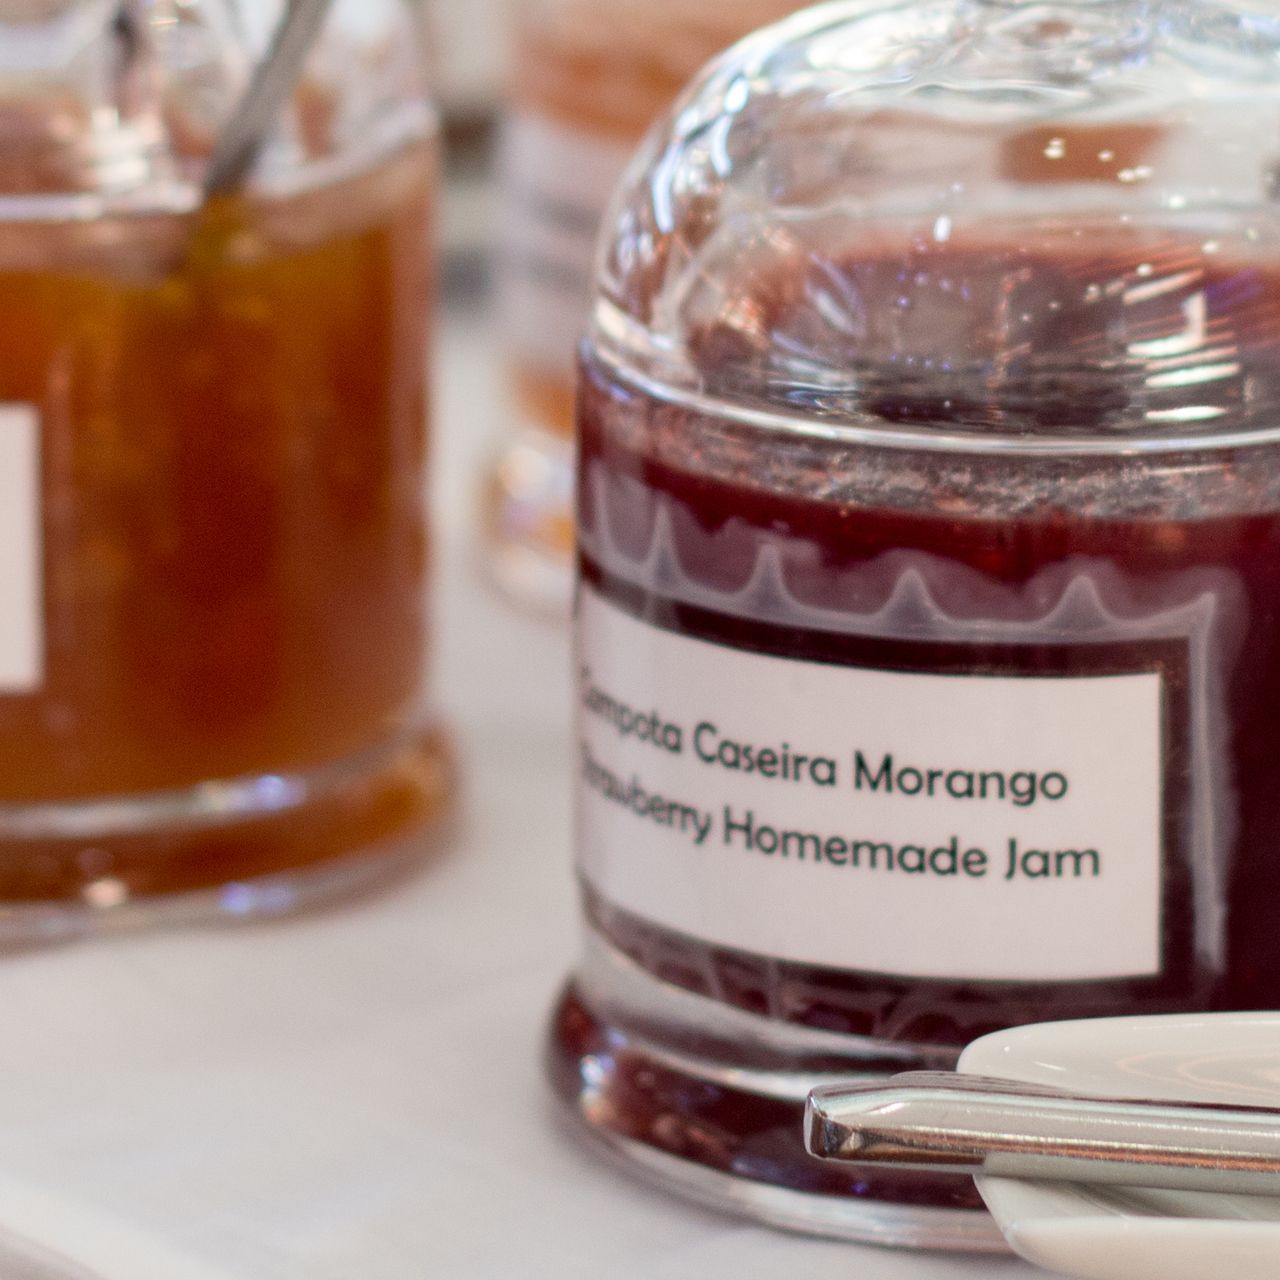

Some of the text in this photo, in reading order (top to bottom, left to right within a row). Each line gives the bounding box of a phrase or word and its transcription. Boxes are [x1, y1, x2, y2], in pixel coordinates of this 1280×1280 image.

[581, 666, 1069, 808] ompota Caseira Morango
[723, 804, 988, 878] Homemade
[1004, 836, 1101, 881] Jam
